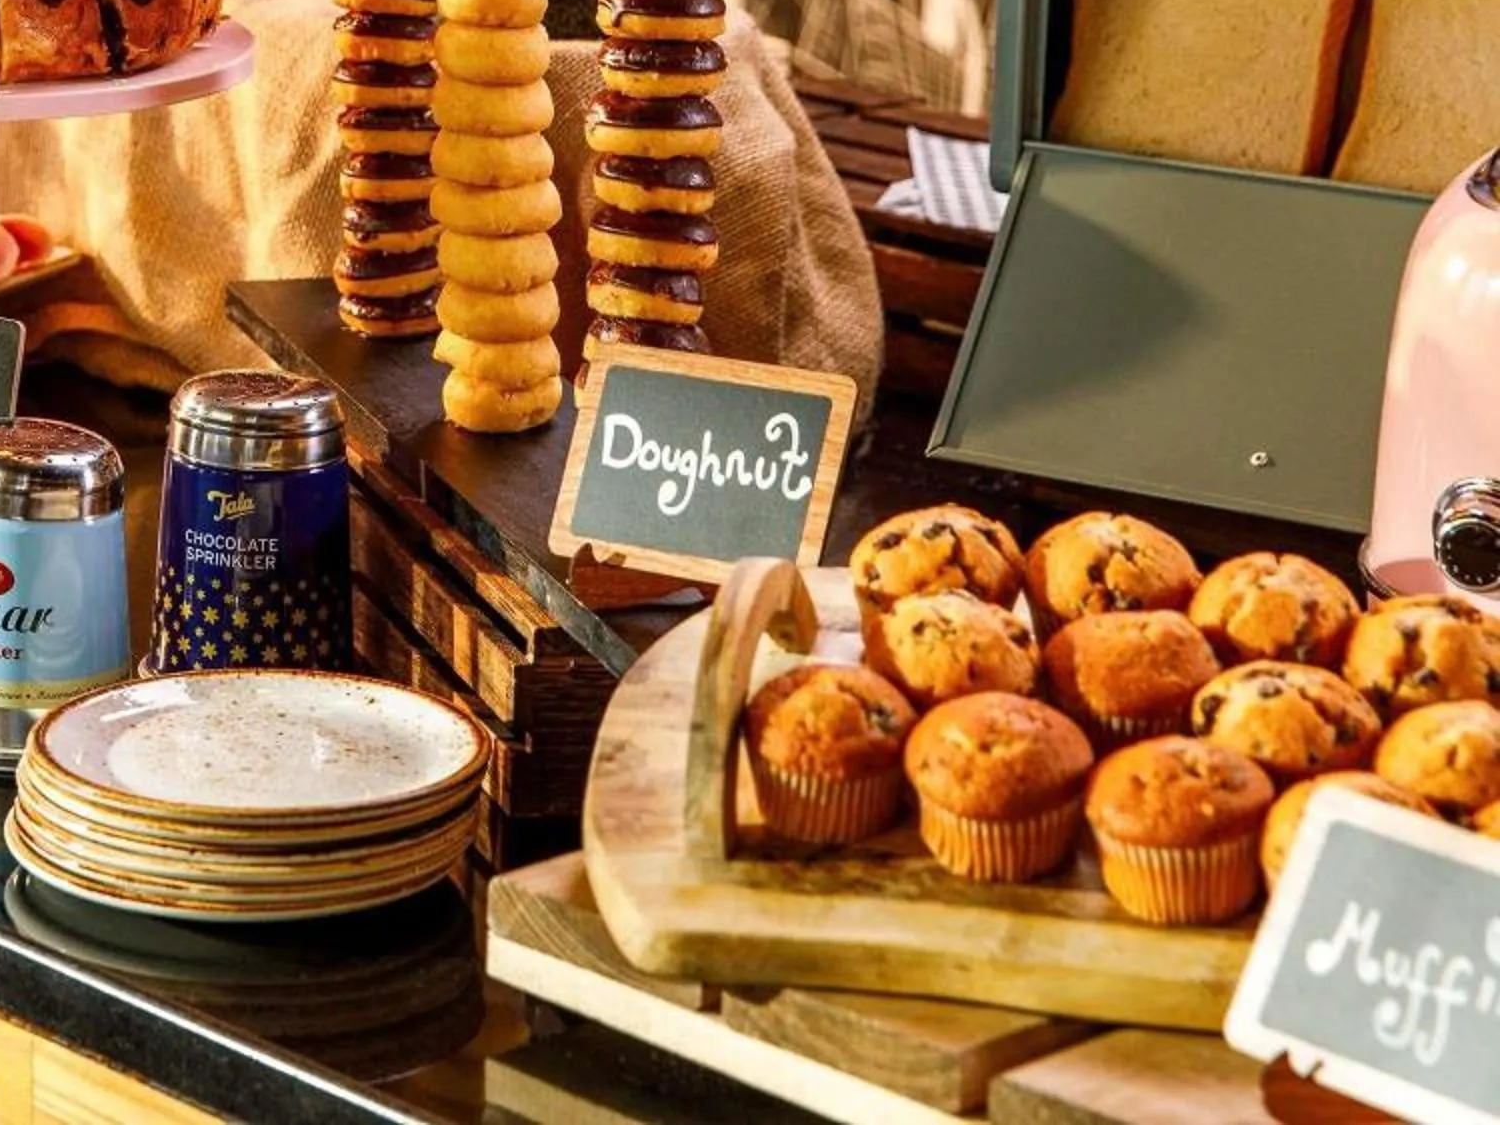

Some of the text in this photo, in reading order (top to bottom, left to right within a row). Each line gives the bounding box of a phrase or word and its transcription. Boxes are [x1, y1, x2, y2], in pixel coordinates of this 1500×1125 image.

[601, 412, 812, 515] Doughnut
[207, 491, 255, 521] Tala
[185, 528, 279, 552] CHOCOLATE
[186, 547, 277, 570] SPRINKLER
[1306, 901, 1500, 1066] Muffi
